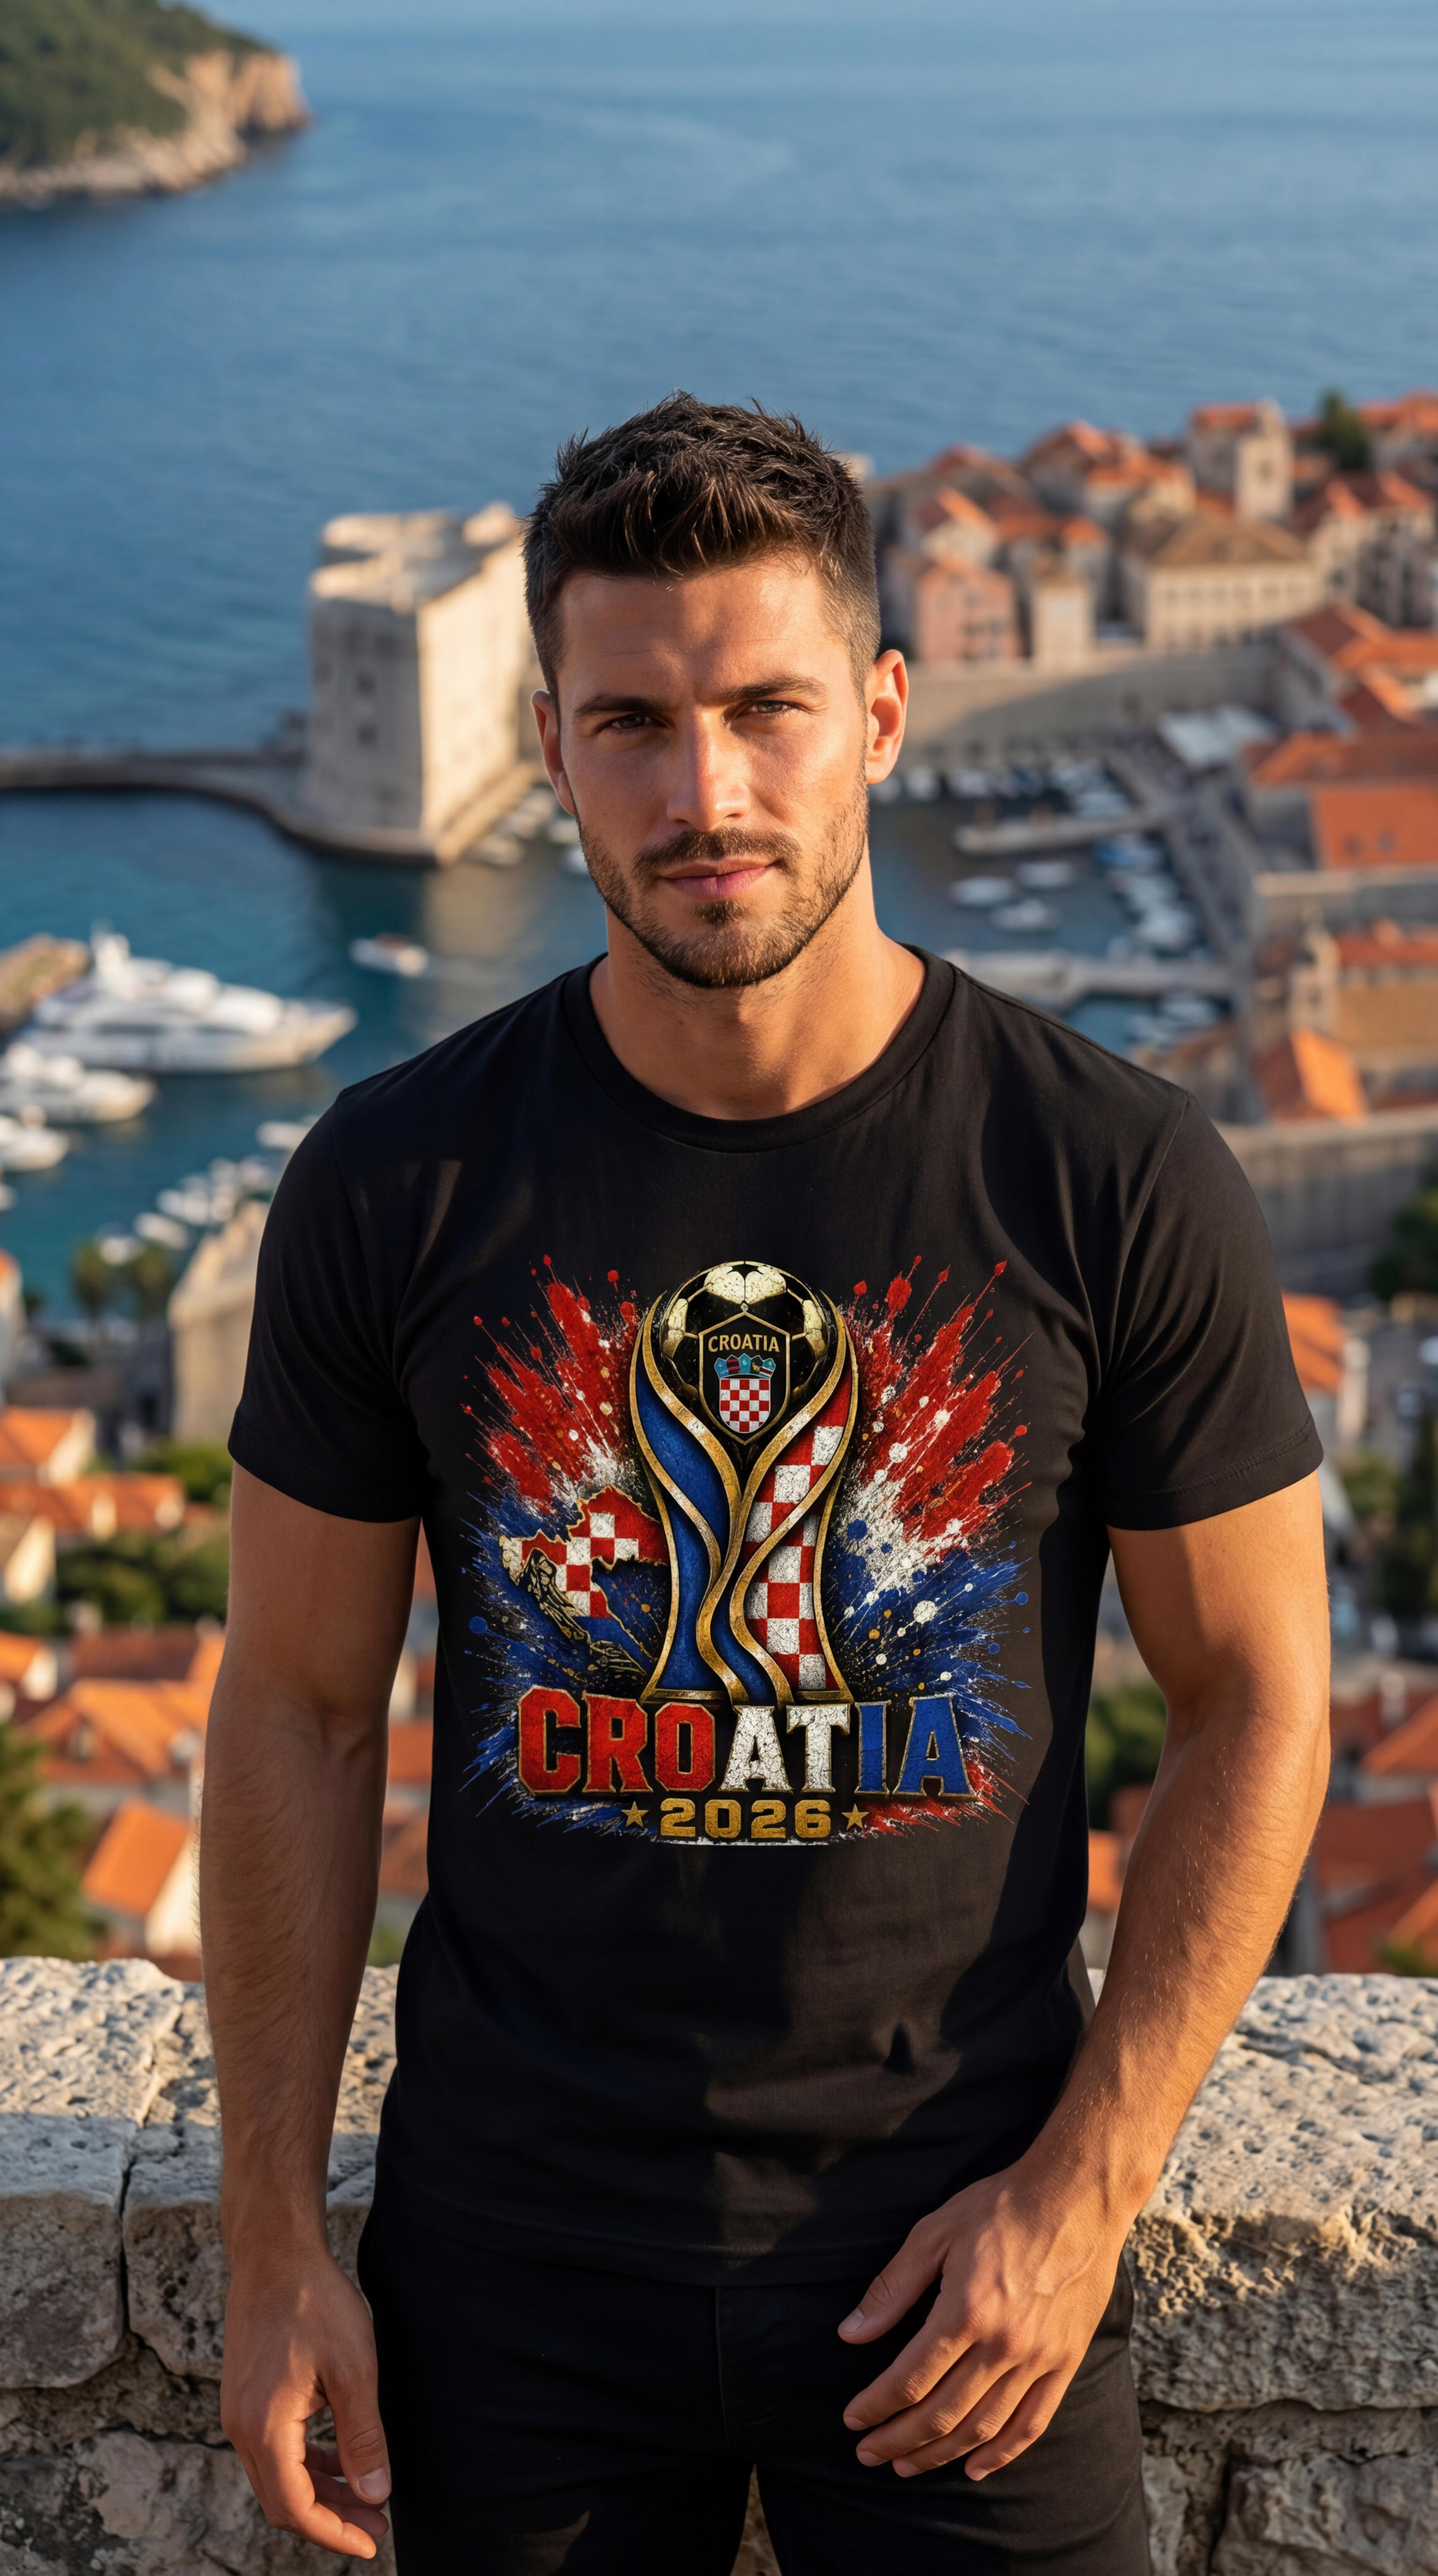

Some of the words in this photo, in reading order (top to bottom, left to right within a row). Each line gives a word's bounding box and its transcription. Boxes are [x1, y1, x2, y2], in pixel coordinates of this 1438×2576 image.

[708, 1333, 780, 1353] CROATIA
[517, 1685, 976, 1796] CROATIA
[660, 1798, 831, 1838] 2026
